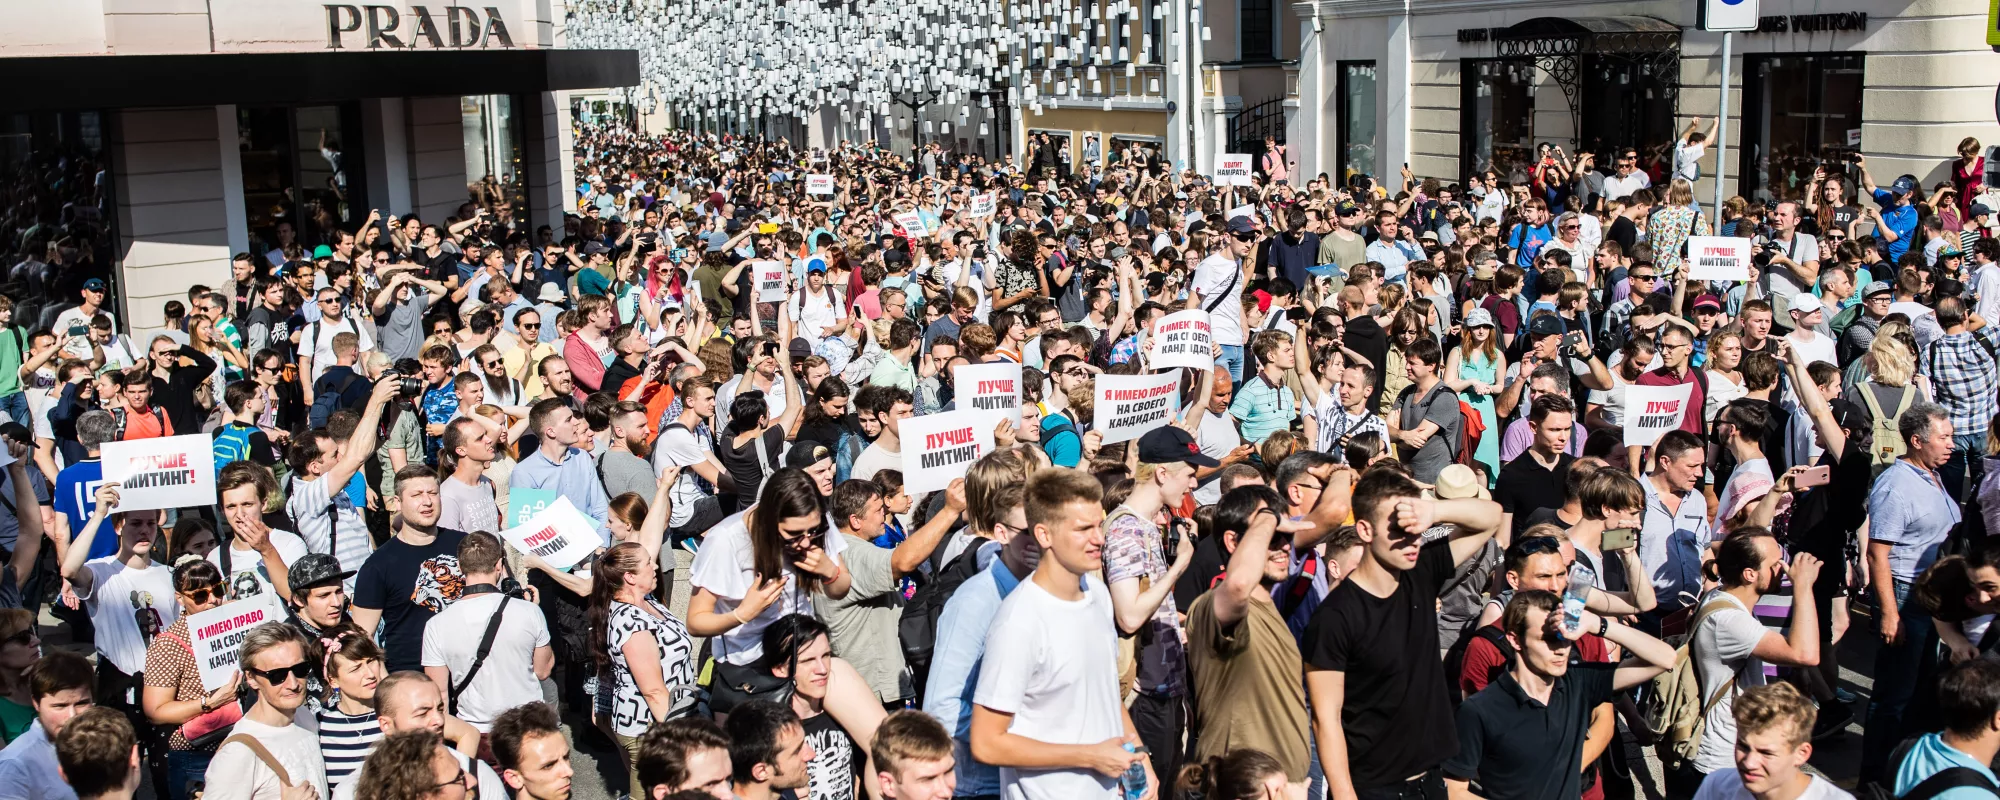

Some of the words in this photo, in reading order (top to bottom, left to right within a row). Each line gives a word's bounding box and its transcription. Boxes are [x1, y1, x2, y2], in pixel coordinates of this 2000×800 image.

[321, 4, 517, 48] PRADA
[1704, 247, 1736, 256] ЛУЧШЕ
[1700, 257, 1740, 267] МИТИНГ!
[765, 272, 782, 280] ЛУЧШЕ
[1160, 325, 1165, 334] Я
[1167, 333, 1179, 342] НА
[978, 379, 1014, 394] ЛУЧШЕ
[1105, 389, 1112, 400] Я
[1115, 388, 1148, 400] ИМЕЮ
[1149, 381, 1177, 397] ПРАВО
[972, 395, 1017, 410] МИТИНГ!
[1117, 404, 1130, 415] НА
[1132, 397, 1167, 412] СВОЕГО
[1645, 399, 1680, 414] ЛУЧШЕ
[1109, 408, 1169, 429] КАНДИДАТА!
[926, 427, 974, 450] ЛУЧШЕ
[921, 444, 981, 469] МИТИНГ!
[124, 469, 195, 489] МИТИНГ!
[197, 628, 204, 640] Я
[204, 619, 232, 638] ИМЕЮ
[233, 609, 263, 628] ПРАВО
[210, 639, 223, 652] НА
